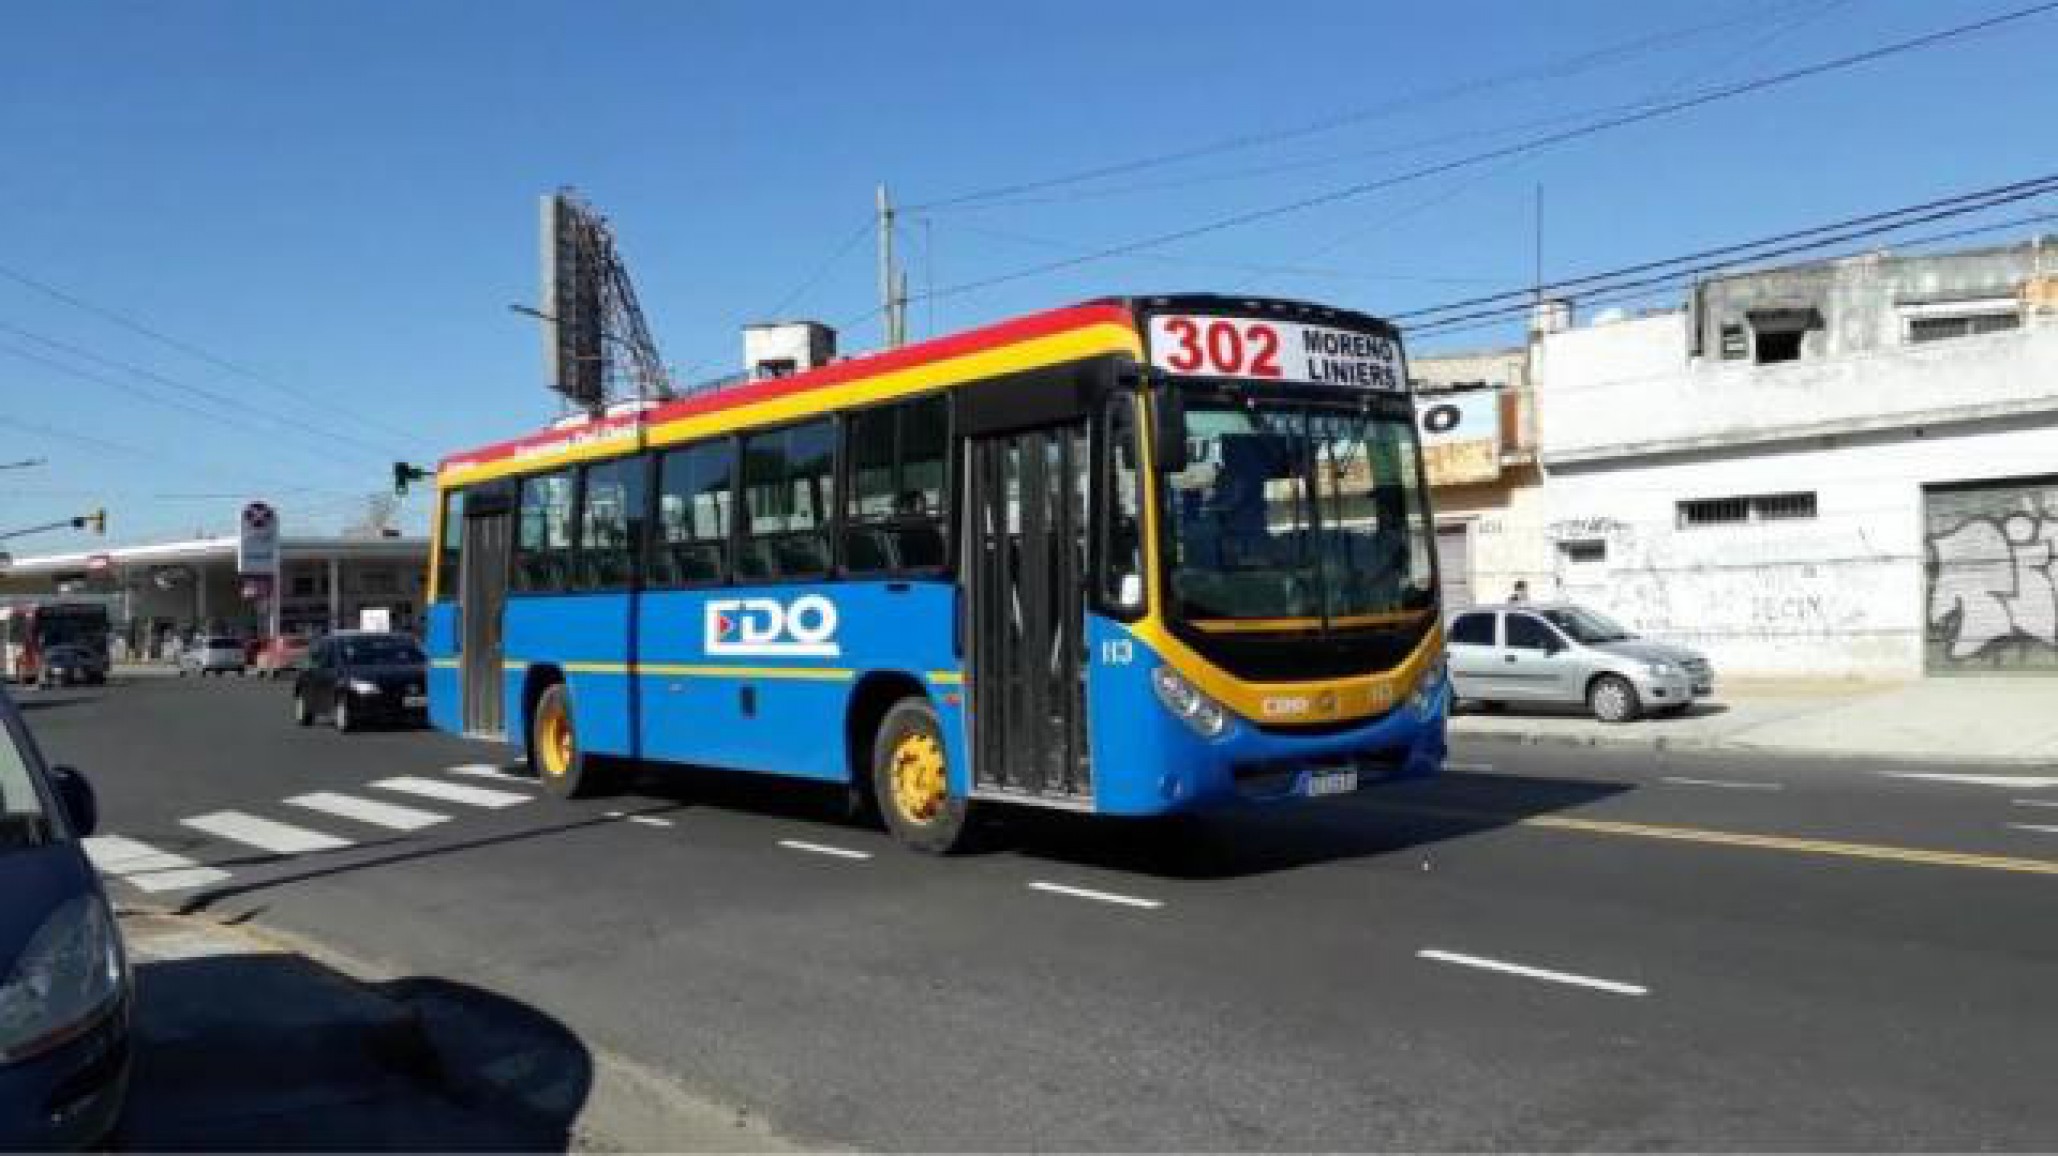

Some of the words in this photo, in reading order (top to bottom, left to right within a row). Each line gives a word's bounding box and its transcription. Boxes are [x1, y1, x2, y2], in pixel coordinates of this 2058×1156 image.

[1163, 316, 1281, 378] 302
[1302, 329, 1393, 361] MORENO
[1307, 358, 1397, 388] LINIERS
[705, 594, 840, 656] EDO
